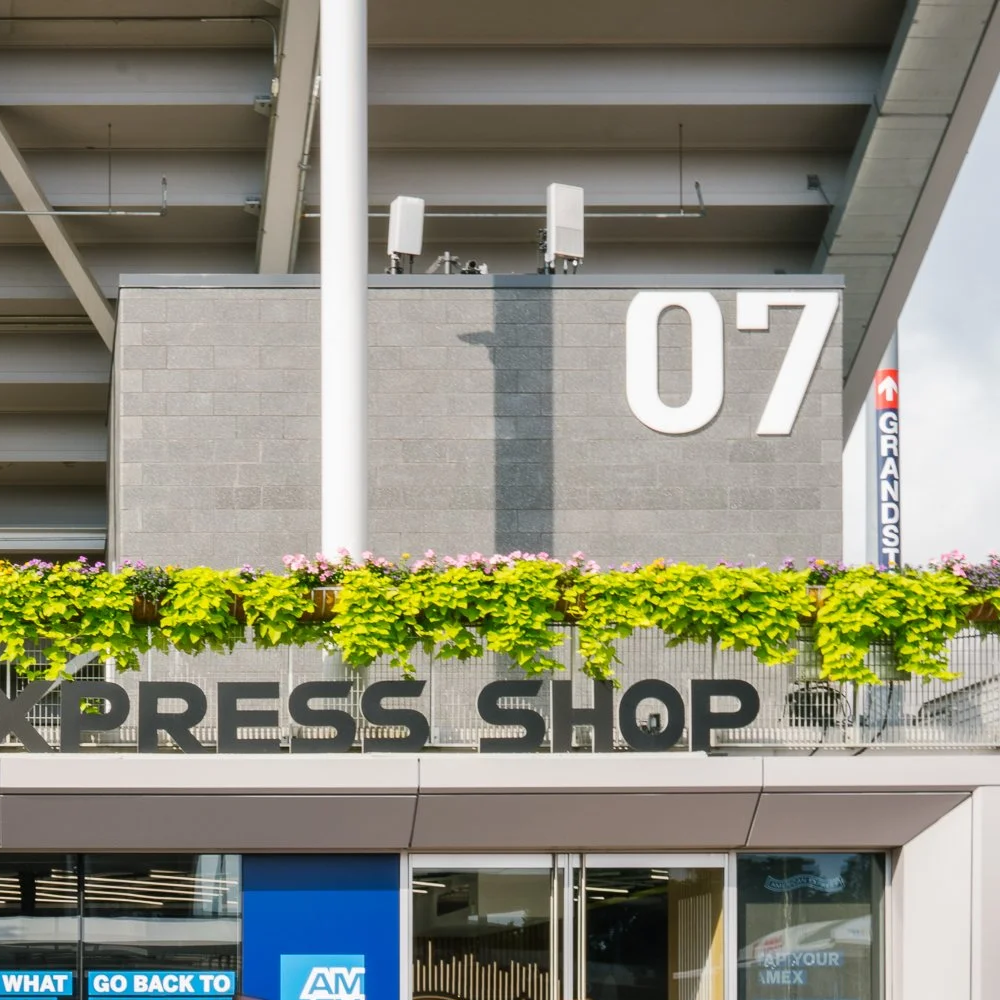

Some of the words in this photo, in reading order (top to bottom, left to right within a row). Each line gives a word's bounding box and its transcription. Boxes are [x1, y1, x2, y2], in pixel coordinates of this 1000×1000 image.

[626, 292, 839, 434] 07
[477, 679, 760, 753] SHOP
[790, 951, 840, 966] YOUR
[1, 974, 68, 993] WHAT
[93, 974, 128, 993] GO
[133, 974, 195, 993] BACK
[198, 974, 231, 993] TO
